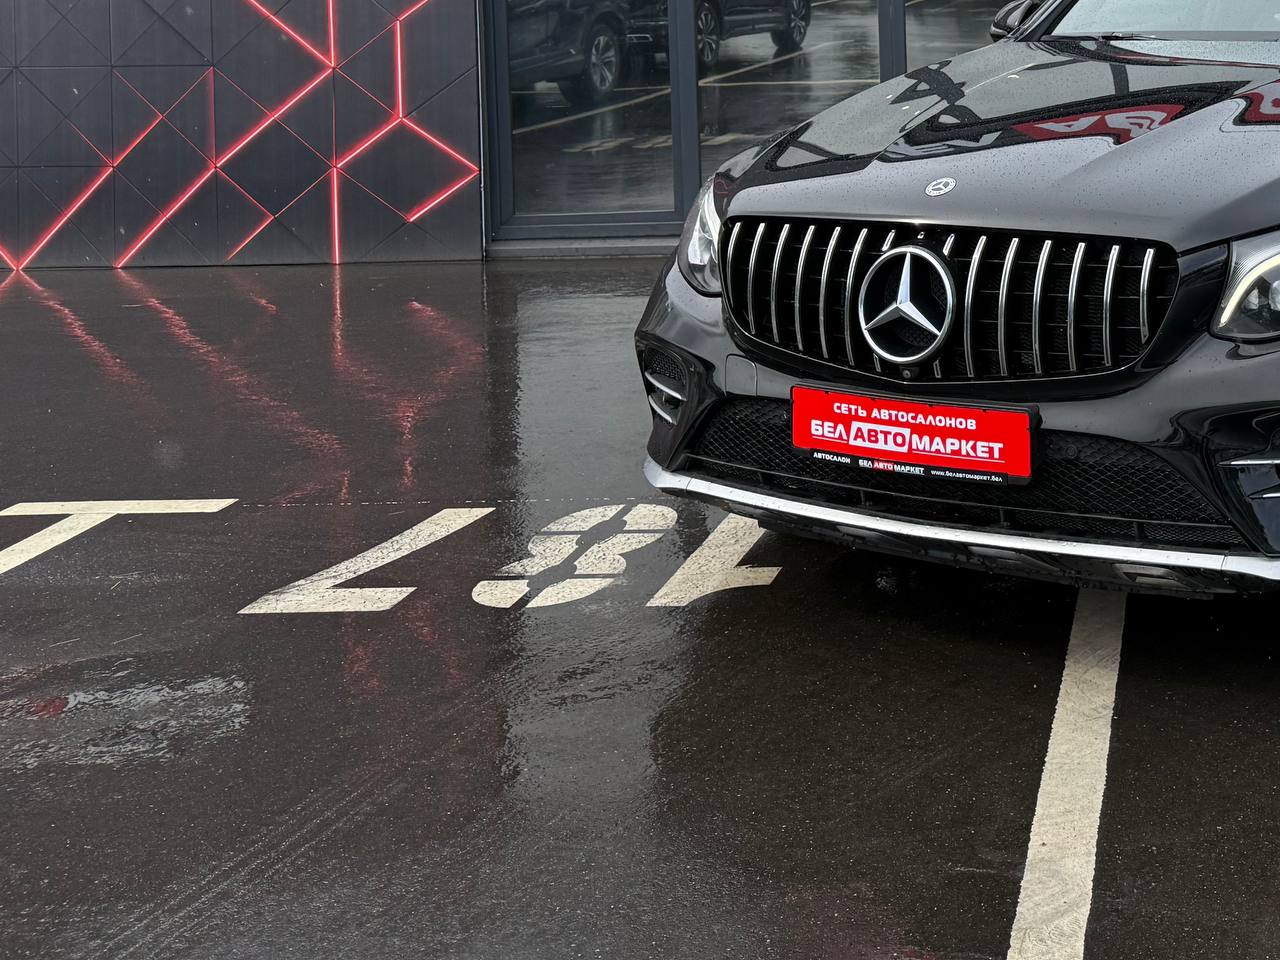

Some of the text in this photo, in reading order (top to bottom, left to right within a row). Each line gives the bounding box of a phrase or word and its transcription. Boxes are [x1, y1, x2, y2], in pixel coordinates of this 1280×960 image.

[833, 402, 977, 430] СЕТЬ АВТОСАЛОНОВ
[811, 419, 1004, 459] БЕЛ АВТО МАРКЕТ
[813, 451, 851, 464] АВТОСАЛОН
[858, 459, 873, 468] БЕЛ
[873, 461, 893, 471] АВТО
[894, 464, 925, 475] МАРКЕТ
